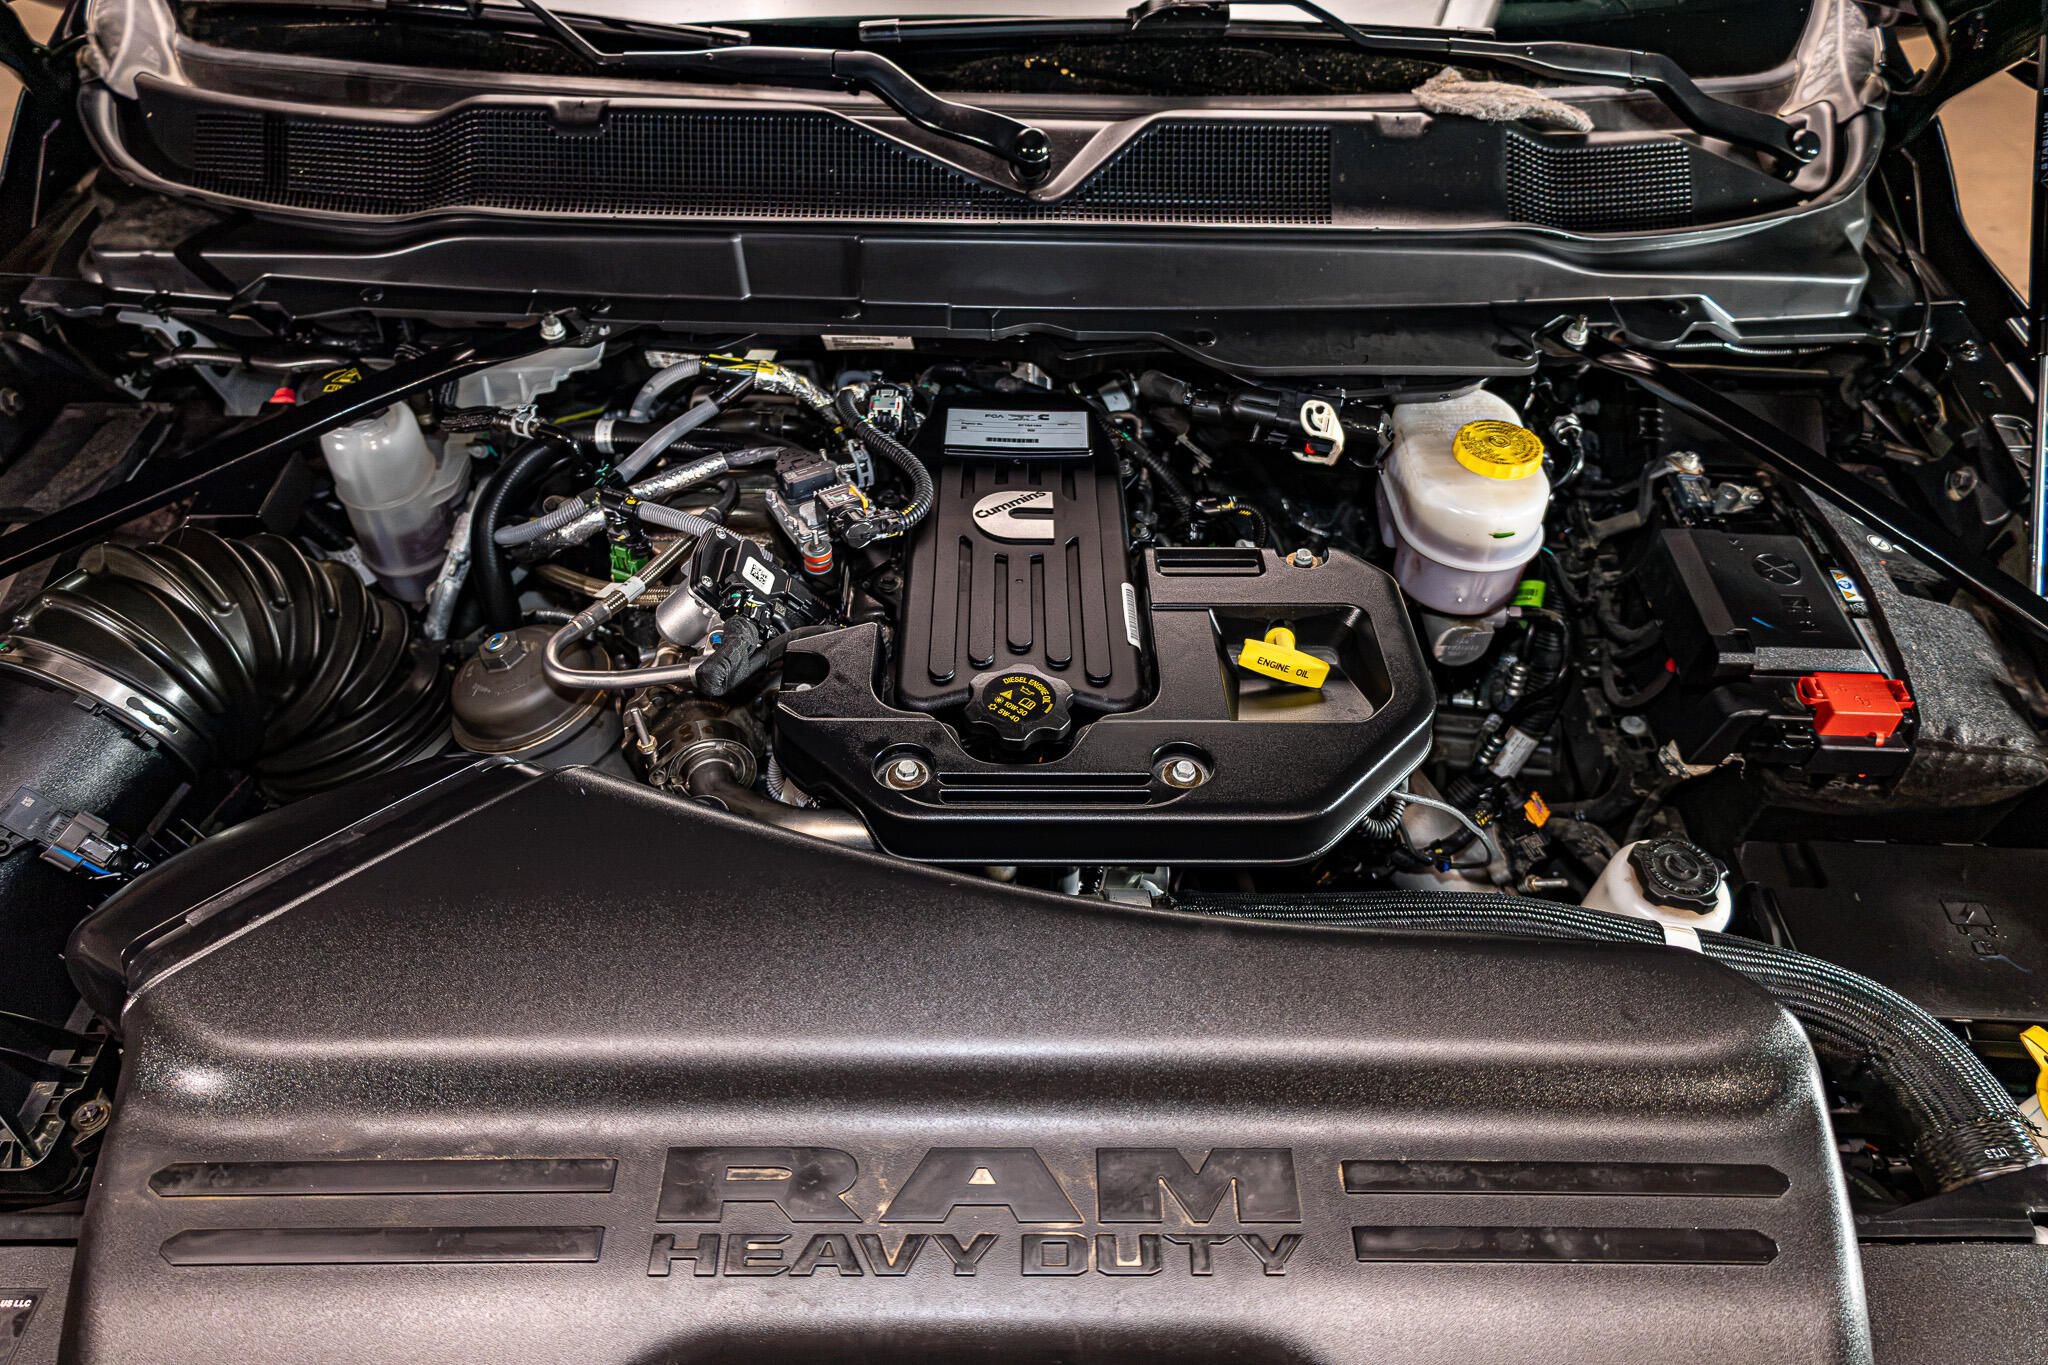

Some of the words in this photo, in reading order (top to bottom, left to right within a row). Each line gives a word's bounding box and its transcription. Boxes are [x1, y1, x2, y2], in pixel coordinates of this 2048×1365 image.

[974, 490, 1047, 519] Cummins
[1257, 656, 1290, 673] ENGINE
[1295, 668, 1310, 679] OIL
[1002, 676, 1028, 684] DIESEL
[1028, 678, 1050, 696] ENGINE
[997, 708, 1021, 723] 5W-40
[1003, 701, 1028, 717] 10W-30
[655, 1146, 1302, 1224] RAM
[646, 1233, 1000, 1277] HEAVY
[1021, 1233, 1303, 1277] DUTY
[13, 1299, 32, 1308] LLC
